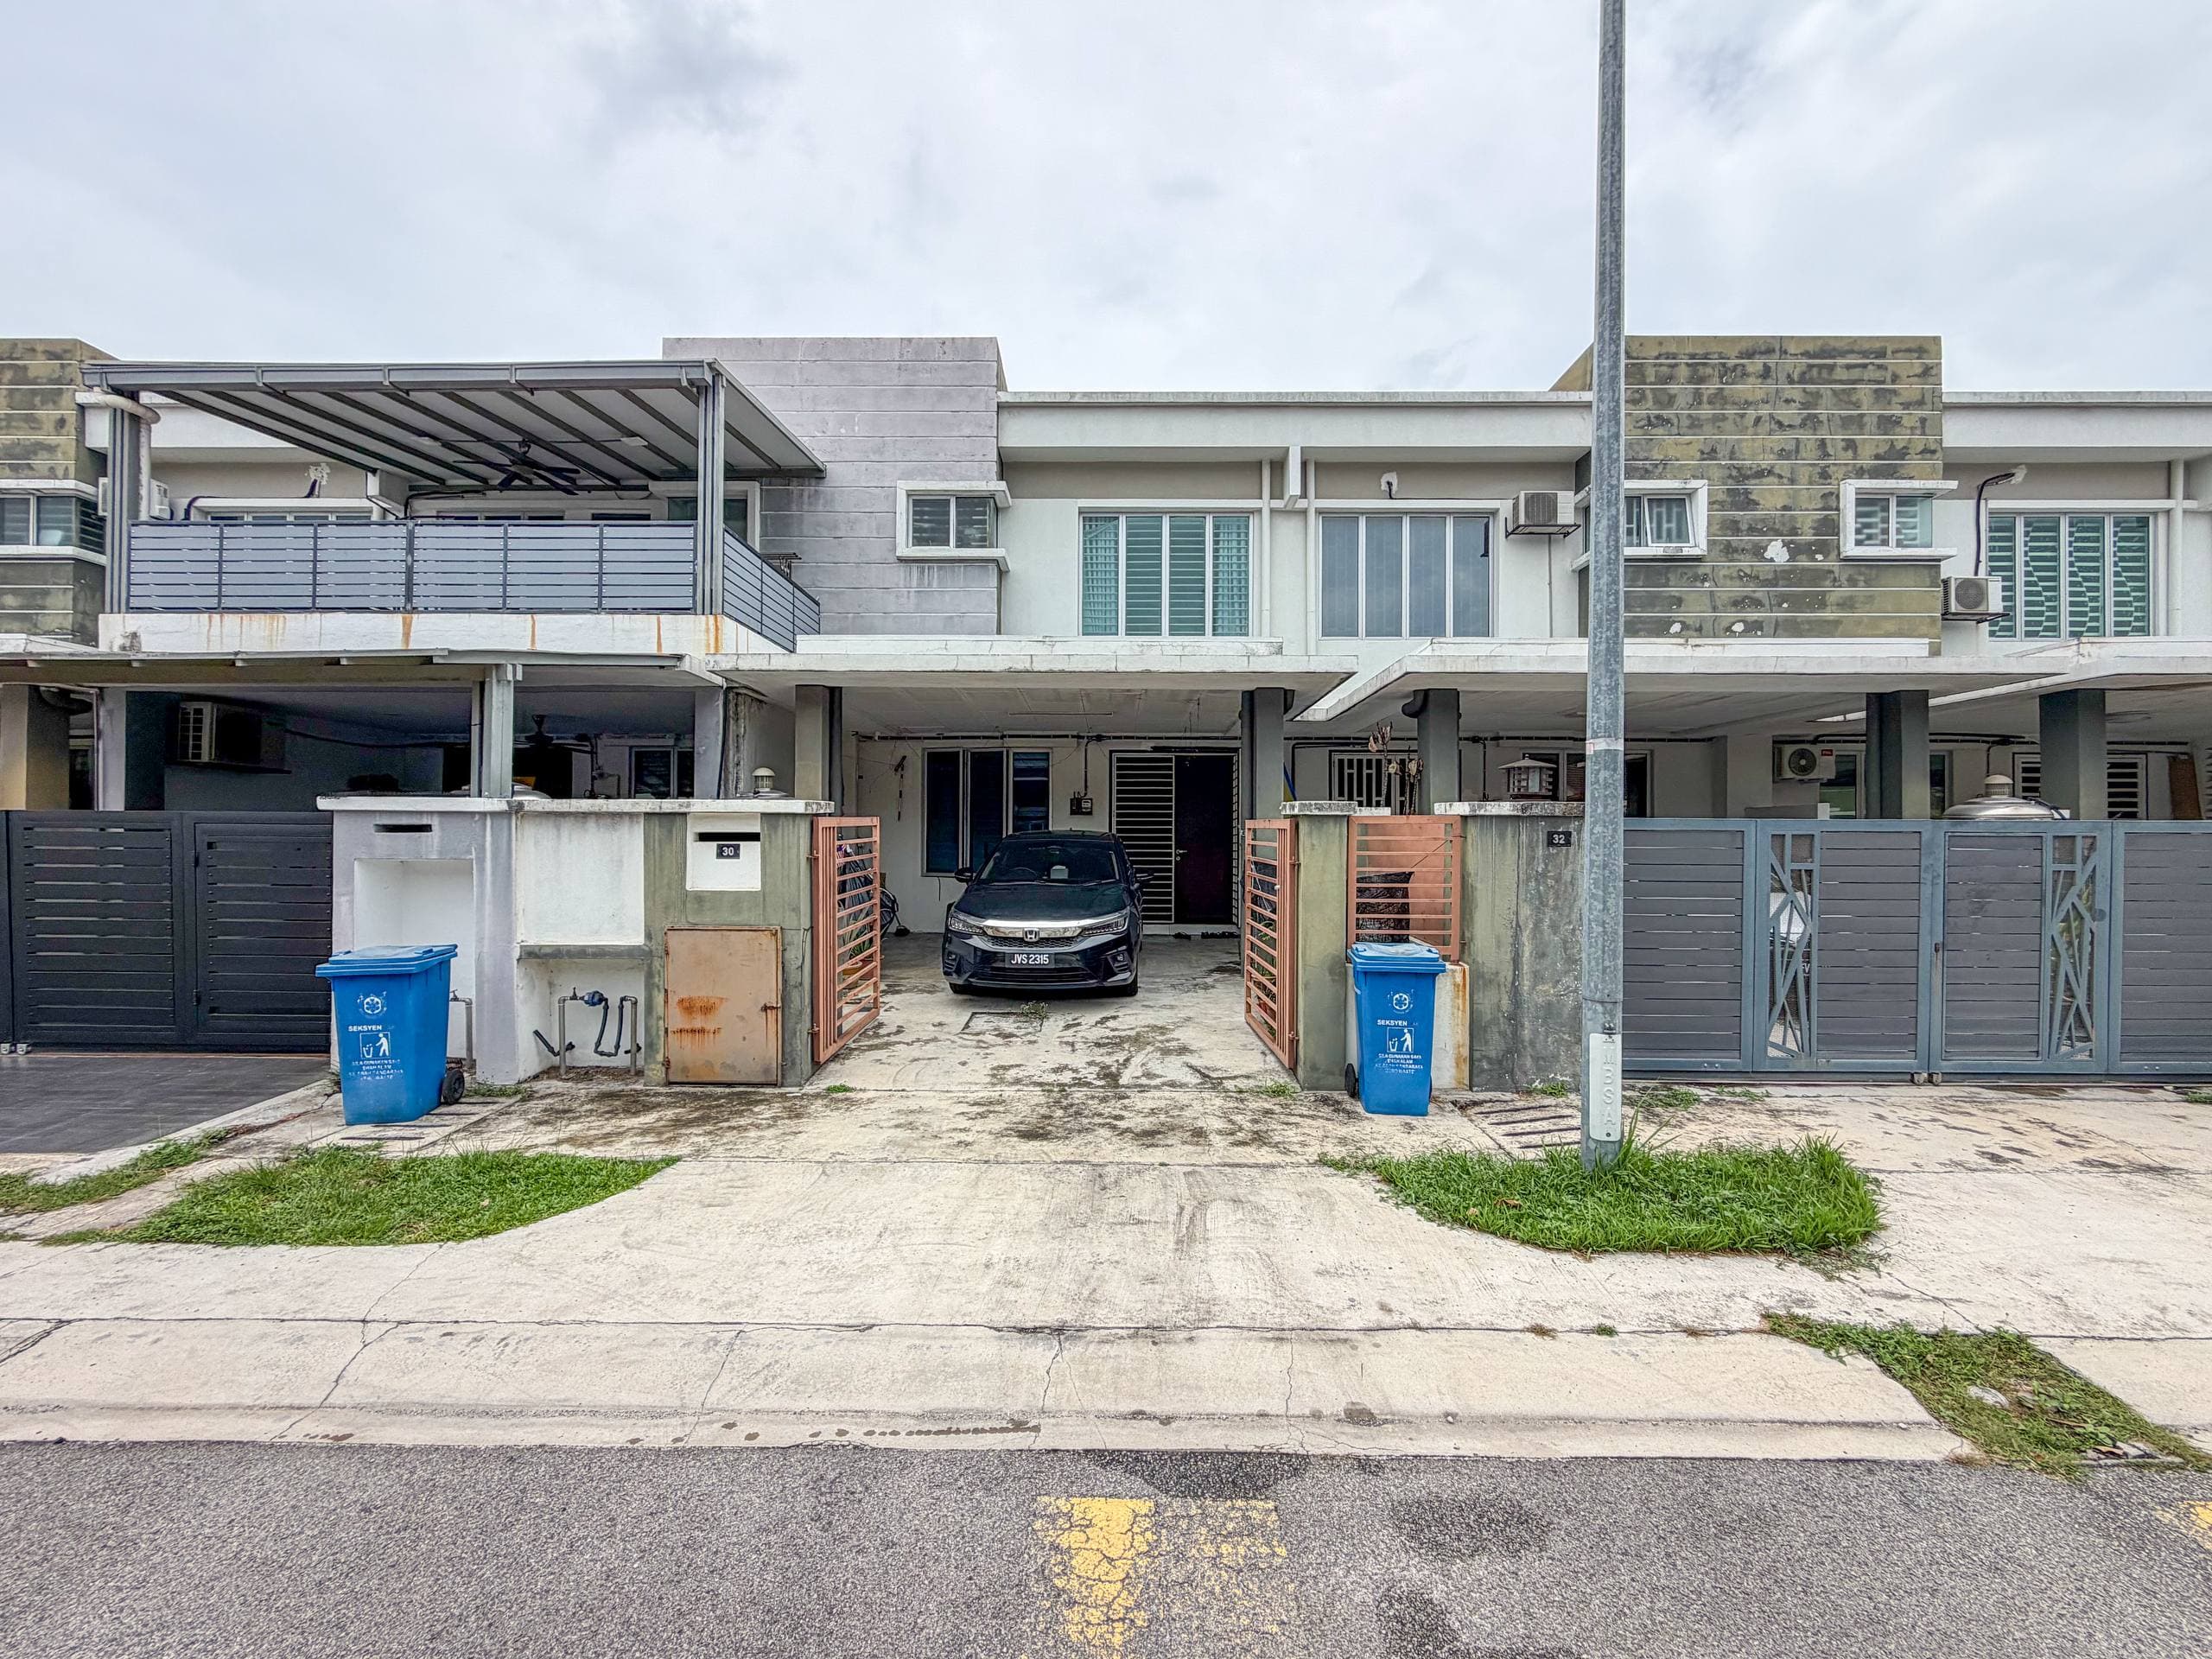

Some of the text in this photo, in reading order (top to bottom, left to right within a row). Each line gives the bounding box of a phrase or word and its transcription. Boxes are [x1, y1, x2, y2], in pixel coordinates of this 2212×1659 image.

[1552, 834, 1566, 844] 32
[721, 846, 734, 856] 30
[1011, 954, 1049, 964] JVS 2315
